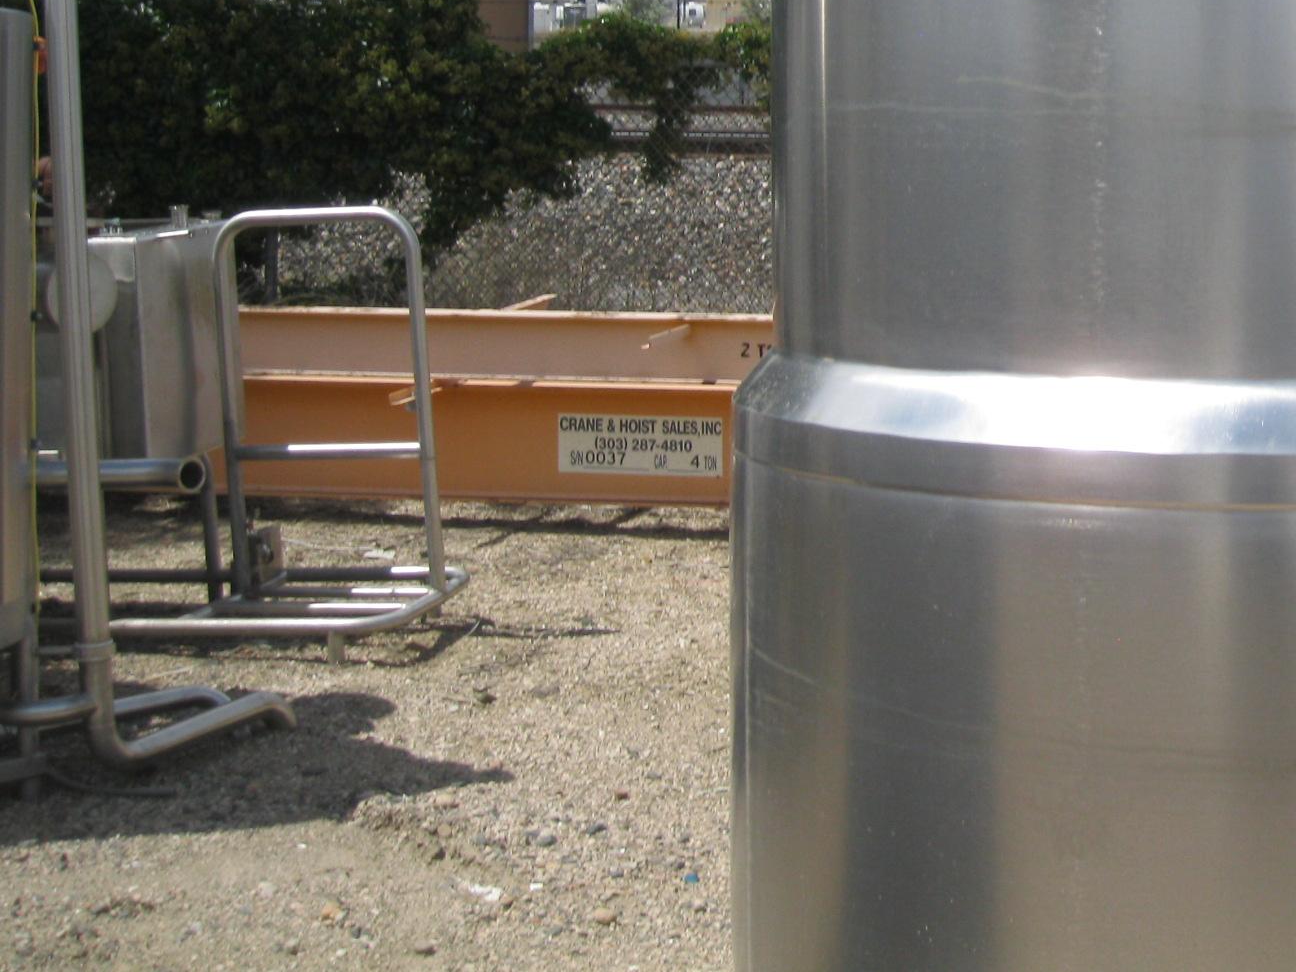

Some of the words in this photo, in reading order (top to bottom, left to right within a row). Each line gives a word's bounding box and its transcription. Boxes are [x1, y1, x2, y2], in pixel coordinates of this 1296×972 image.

[741, 342, 750, 358] 2
[559, 416, 603, 432] CRANE
[607, 418, 616, 433] &
[619, 419, 657, 434] HOIST
[594, 436, 628, 451] (303)
[631, 438, 693, 453] 287-4810
[570, 450, 583, 465] S/N
[585, 451, 626, 465] 0037
[690, 454, 700, 469] 4
[704, 456, 717, 470] TON
